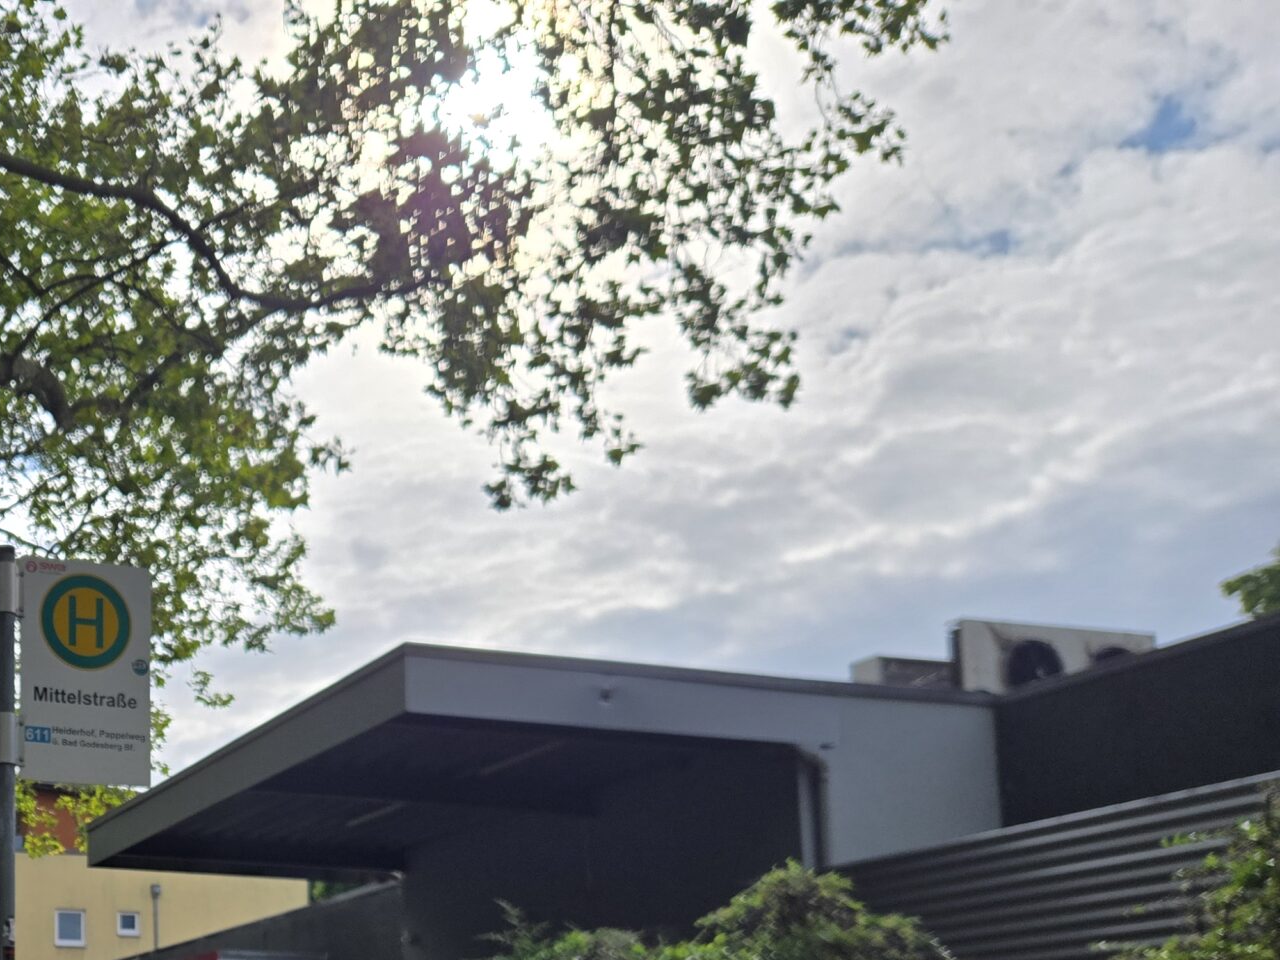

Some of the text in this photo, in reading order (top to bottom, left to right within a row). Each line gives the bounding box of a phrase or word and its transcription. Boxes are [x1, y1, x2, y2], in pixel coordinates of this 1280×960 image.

[68, 595, 104, 649] H
[33, 686, 137, 709] Mittelstraße
[26, 727, 50, 743] 611
